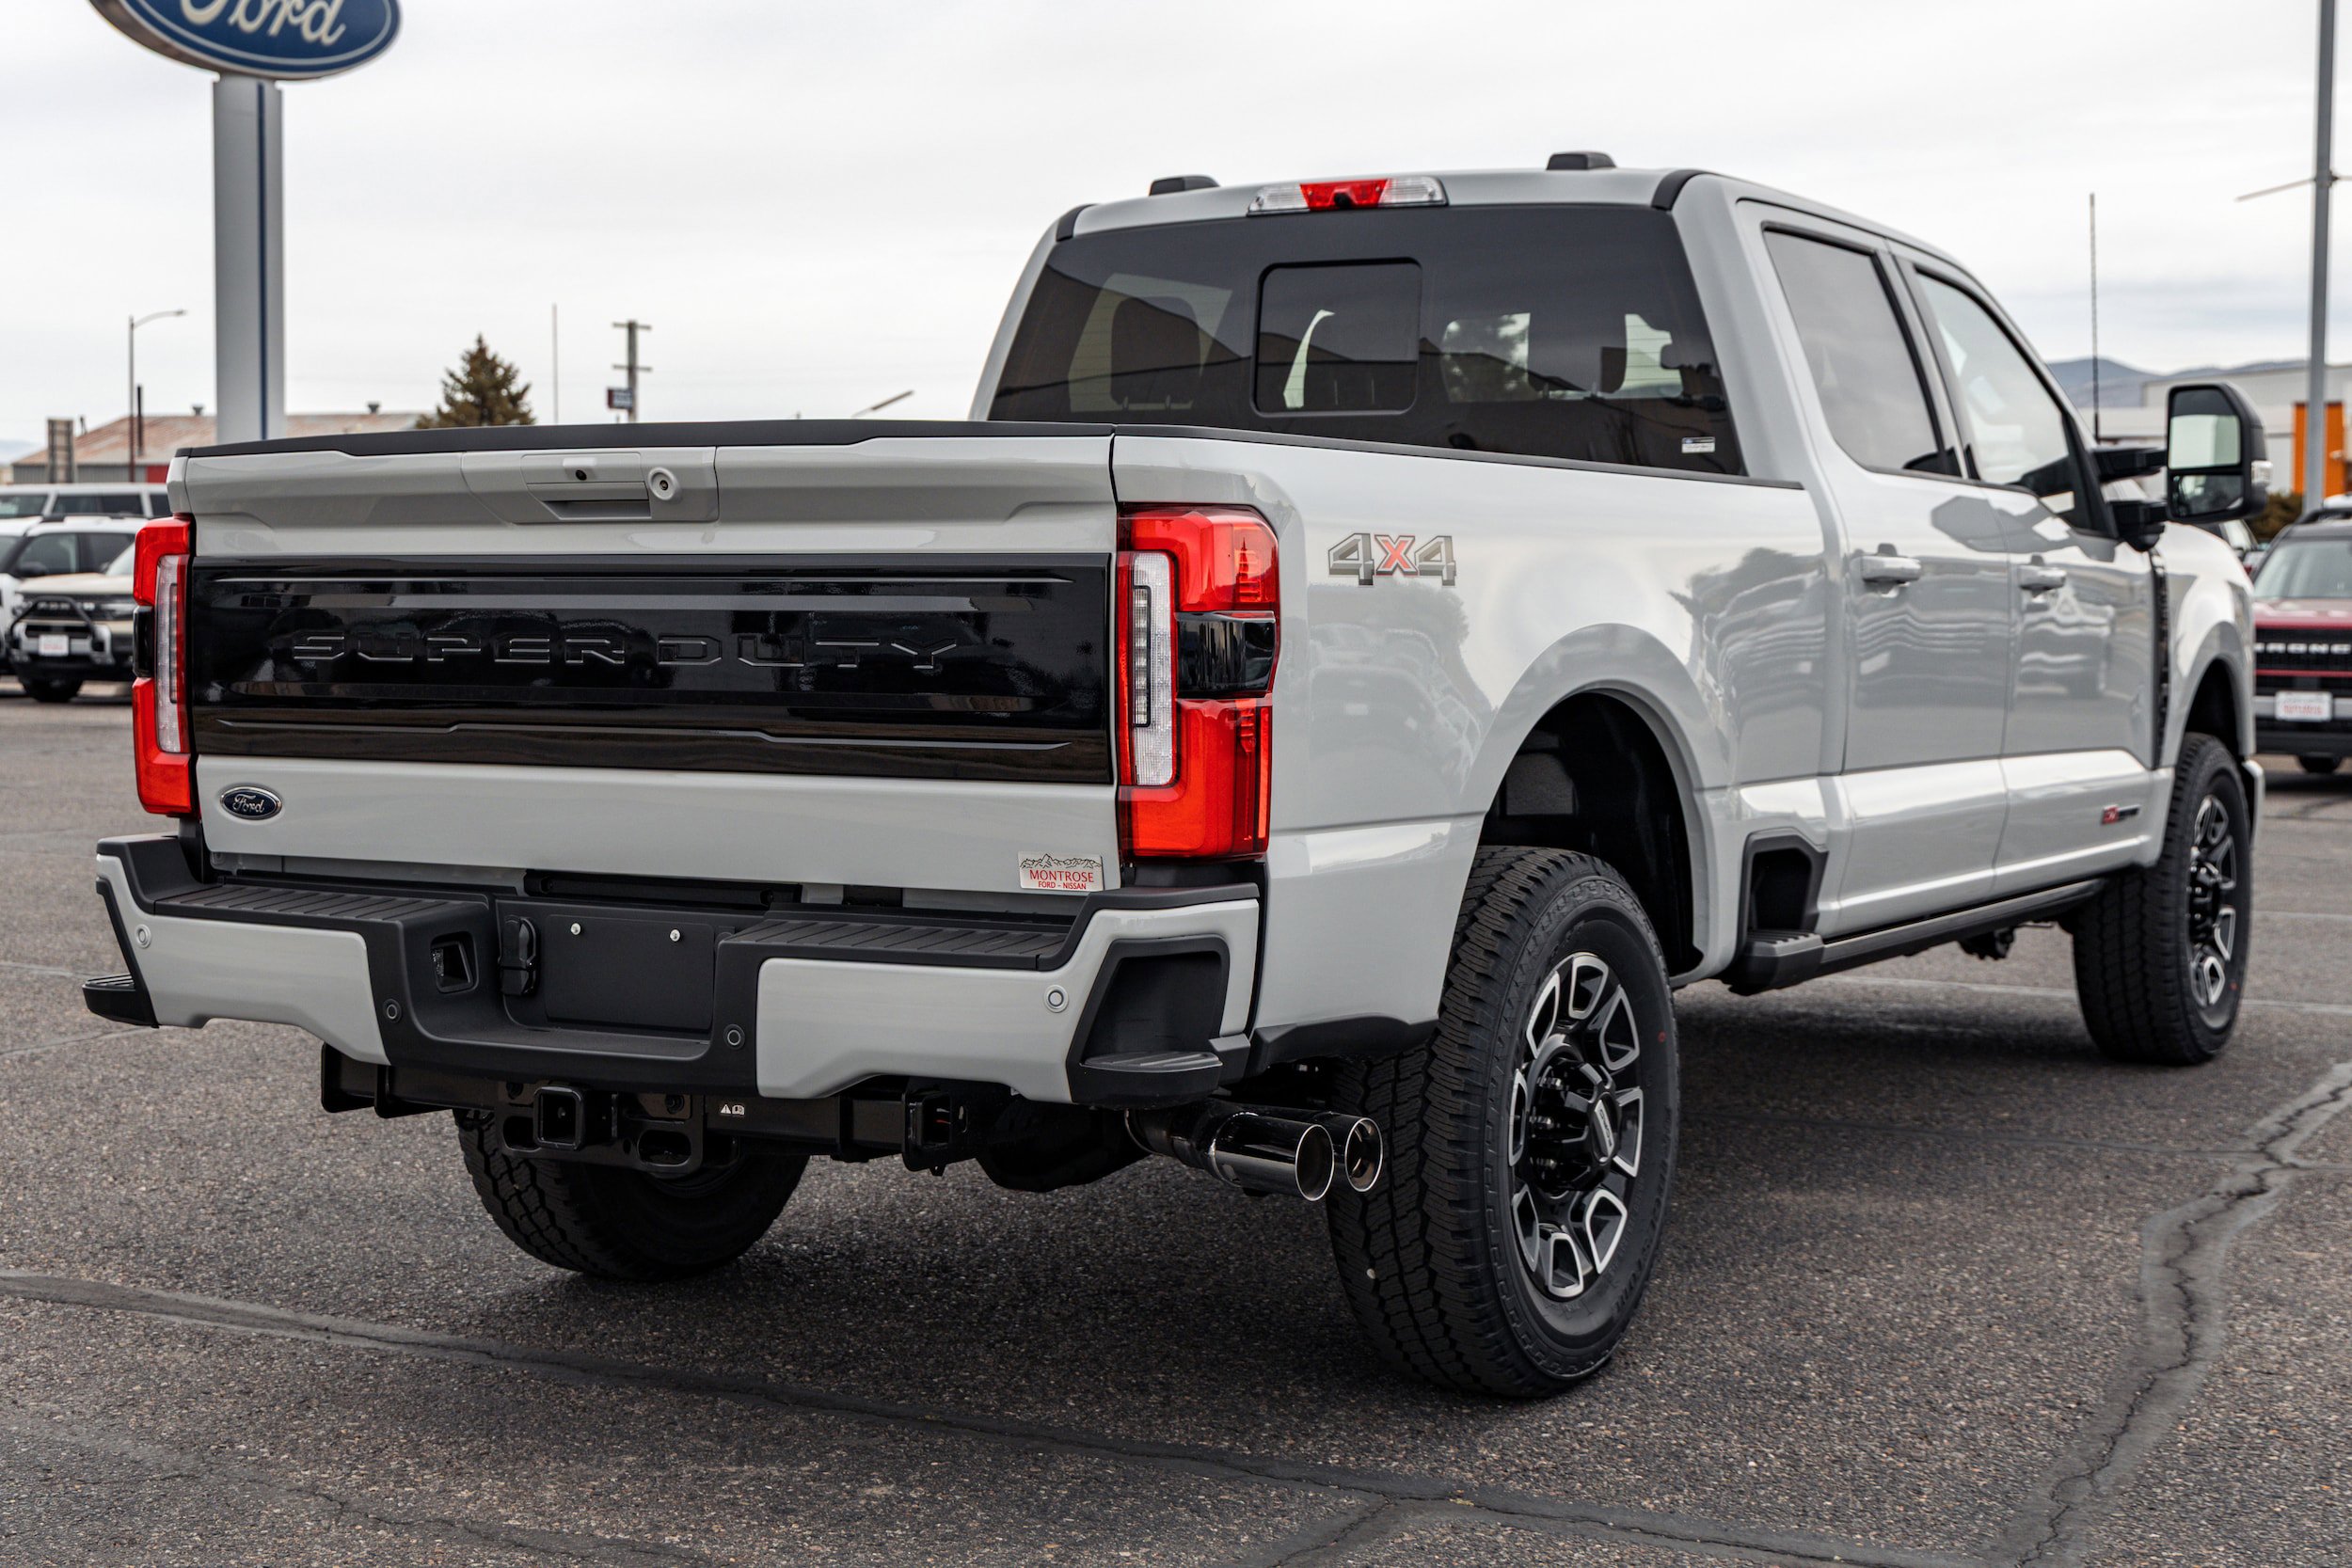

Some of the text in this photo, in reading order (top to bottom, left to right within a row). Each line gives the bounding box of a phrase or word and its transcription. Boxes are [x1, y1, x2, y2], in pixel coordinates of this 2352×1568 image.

[180, 0, 347, 46] ord
[292, 629, 958, 670] SUPER DUTY
[232, 794, 264, 813] Ford
[1029, 869, 1094, 883] MONTROSE
